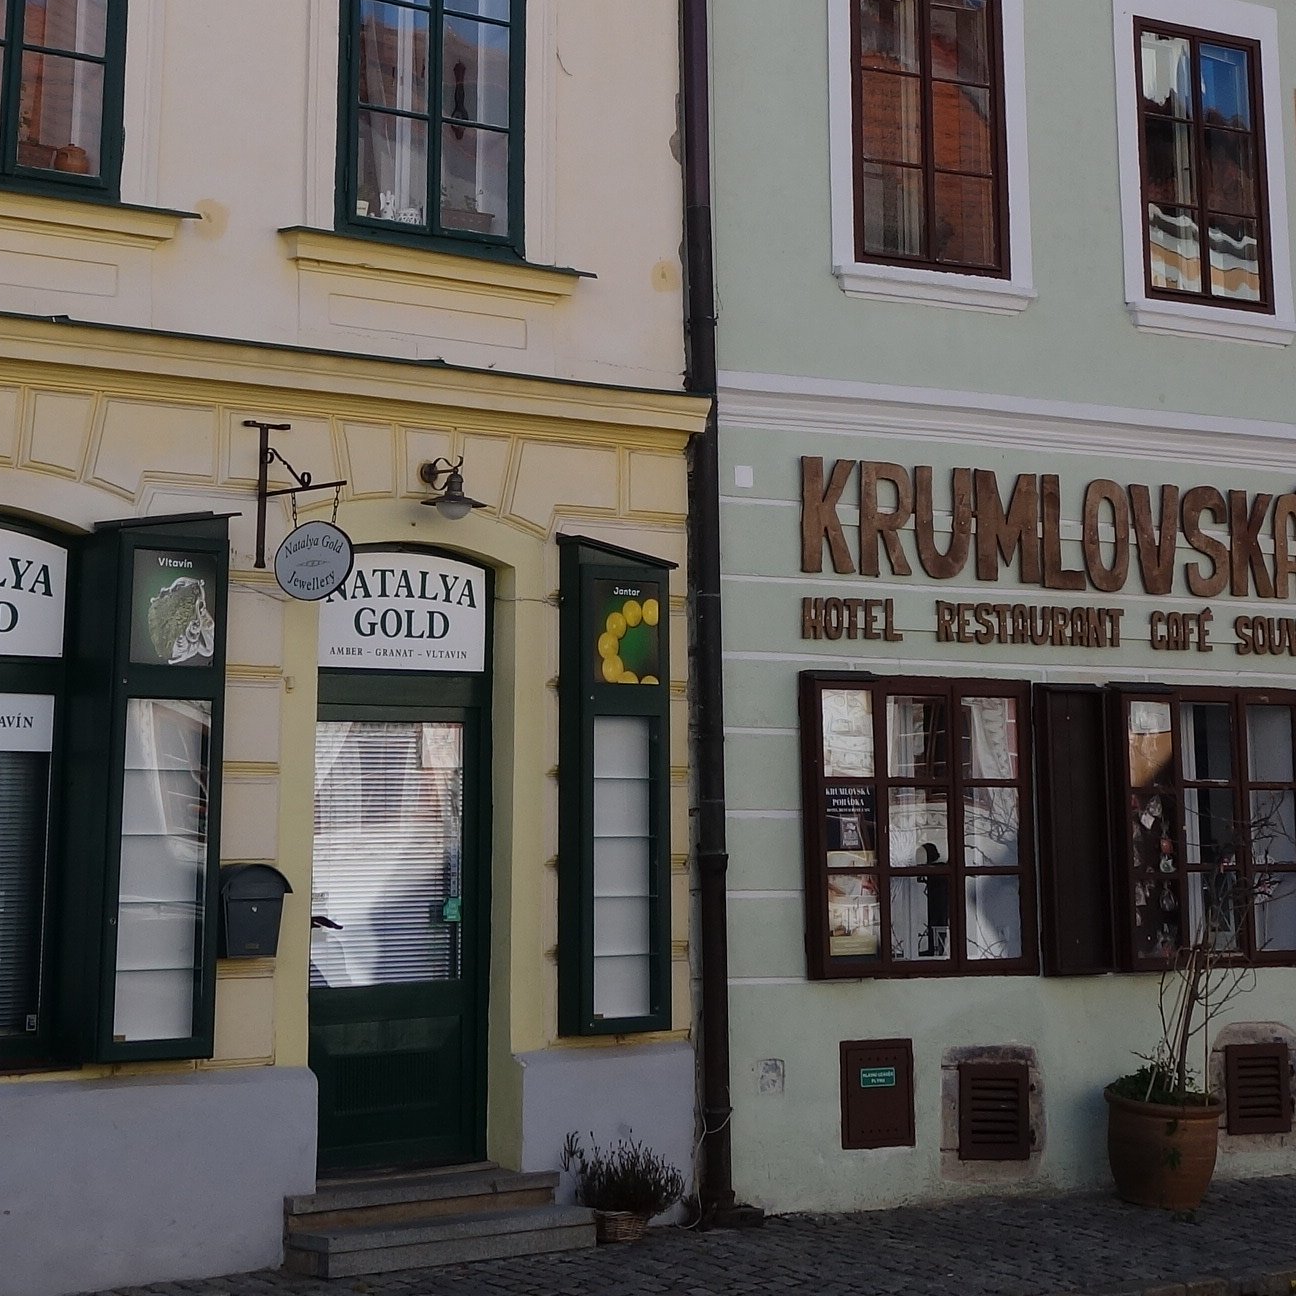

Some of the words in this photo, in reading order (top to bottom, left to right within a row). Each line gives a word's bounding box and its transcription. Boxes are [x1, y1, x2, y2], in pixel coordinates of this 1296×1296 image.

[284, 534, 319, 558] Natalya
[321, 534, 344, 554] Gold
[287, 570, 335, 591] Jewellery
[613, 586, 641, 596] Jantar
[354, 607, 450, 639] GOLD
[801, 597, 903, 642] HOTEL
[935, 600, 1124, 648] RESTAURANT
[1150, 606, 1214, 652] CAFÉ
[329, 646, 363, 656] AMBER
